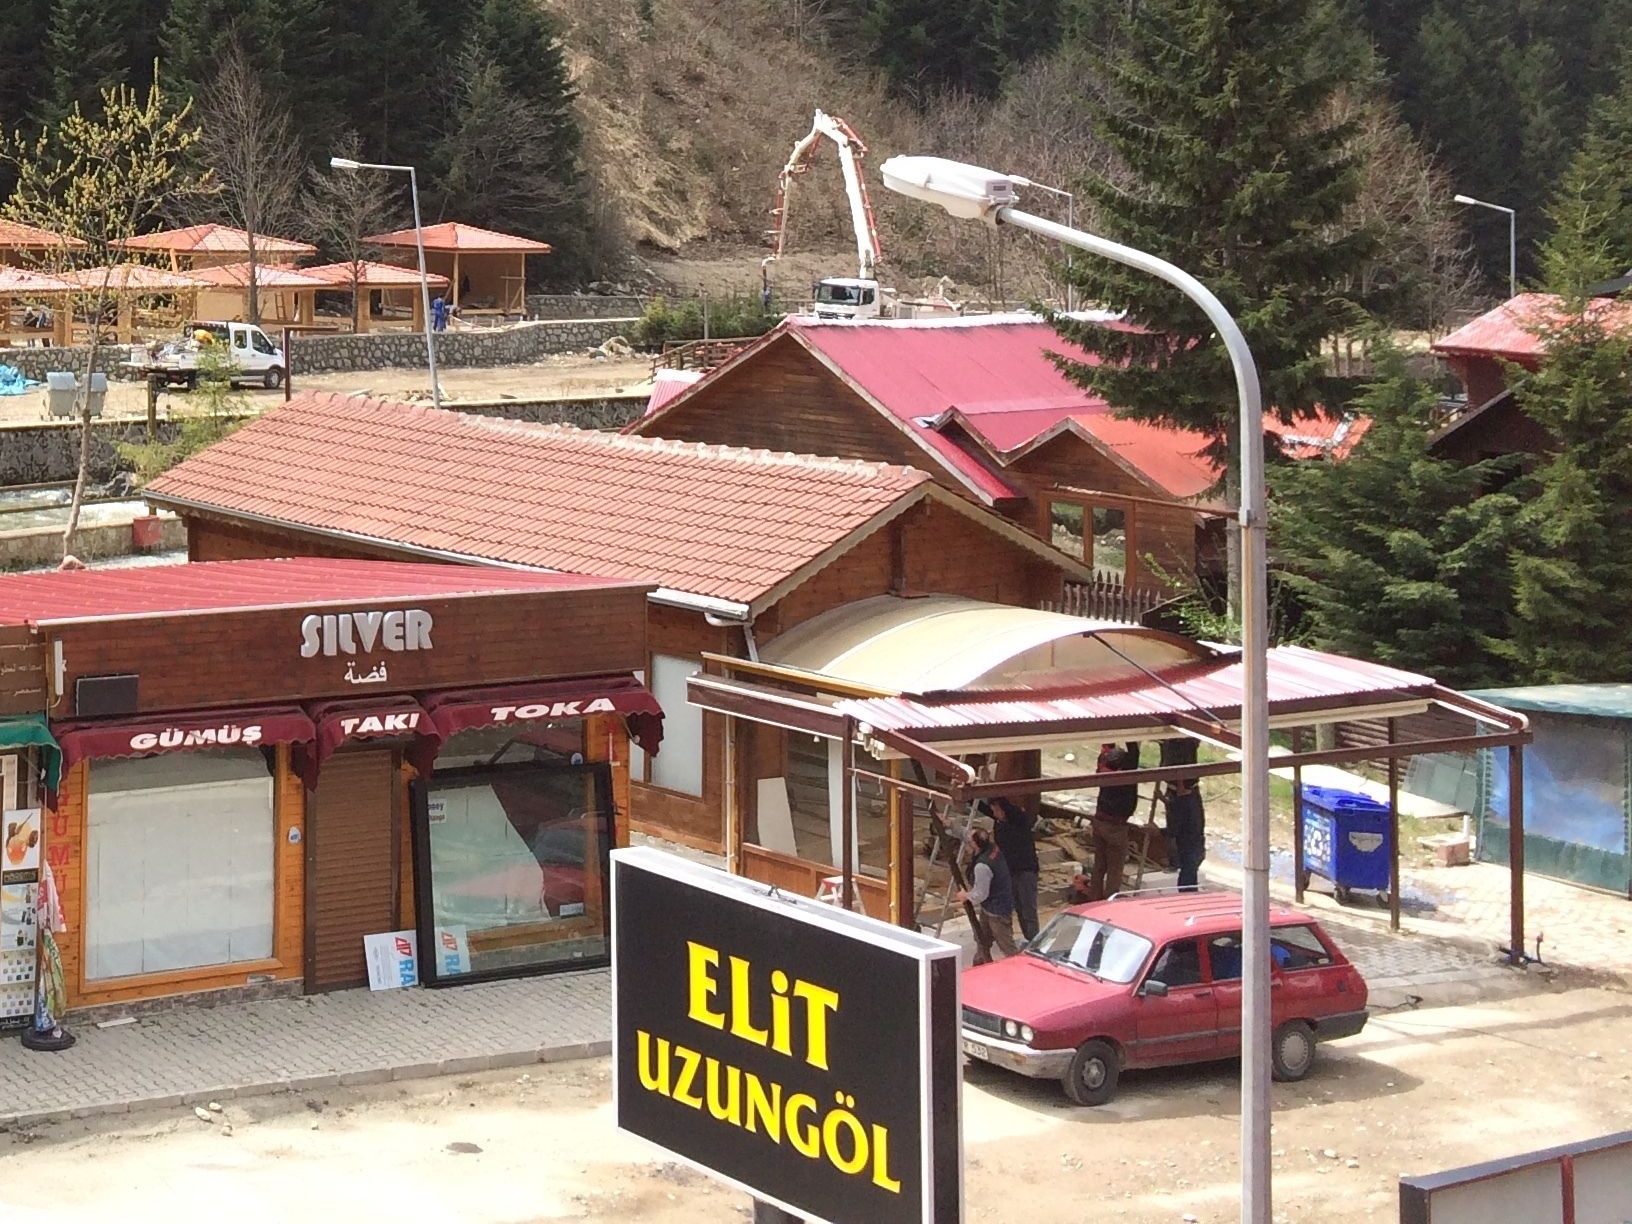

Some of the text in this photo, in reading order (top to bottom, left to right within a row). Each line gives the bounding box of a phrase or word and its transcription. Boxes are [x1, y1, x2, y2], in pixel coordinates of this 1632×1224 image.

[301, 608, 435, 658] SILVER
[343, 661, 388, 685] فضة
[490, 698, 616, 721] TOKA
[340, 712, 420, 735] TAKI
[129, 725, 263, 751] GÜMÜŞ
[636, 1029, 902, 1194] UZUNGÖL
